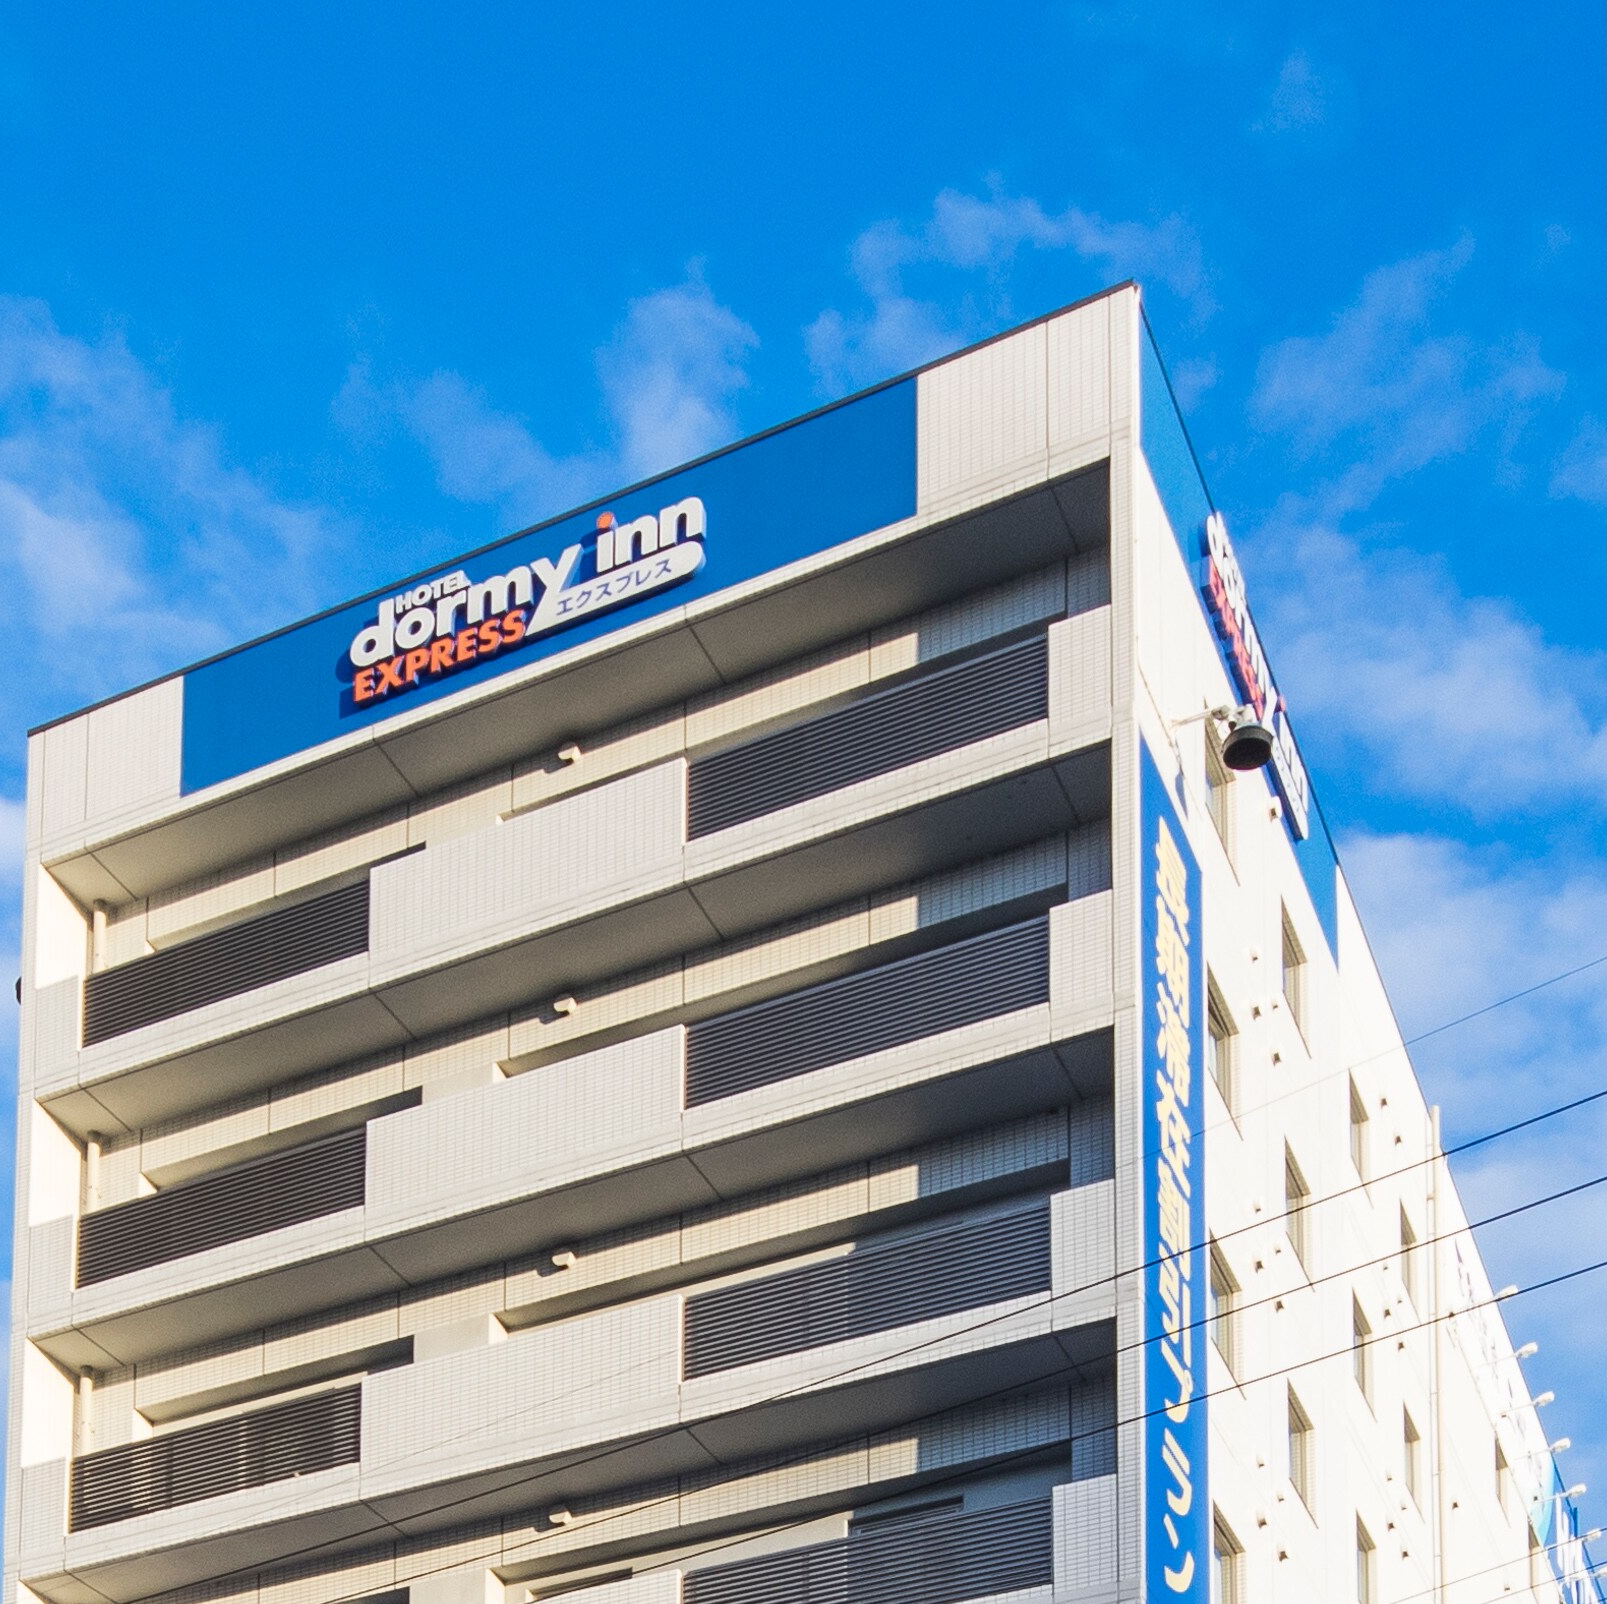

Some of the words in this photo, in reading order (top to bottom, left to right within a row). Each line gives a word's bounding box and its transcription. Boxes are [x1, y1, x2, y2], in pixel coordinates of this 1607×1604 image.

[350, 543, 584, 667] dormy
[596, 497, 706, 573] inn
[394, 569, 471, 614] HOTEL
[556, 558, 673, 616] エクスプレス
[353, 608, 528, 704] EXPRESS
[1156, 815, 1195, 1594] 長期滞在割引プラン
